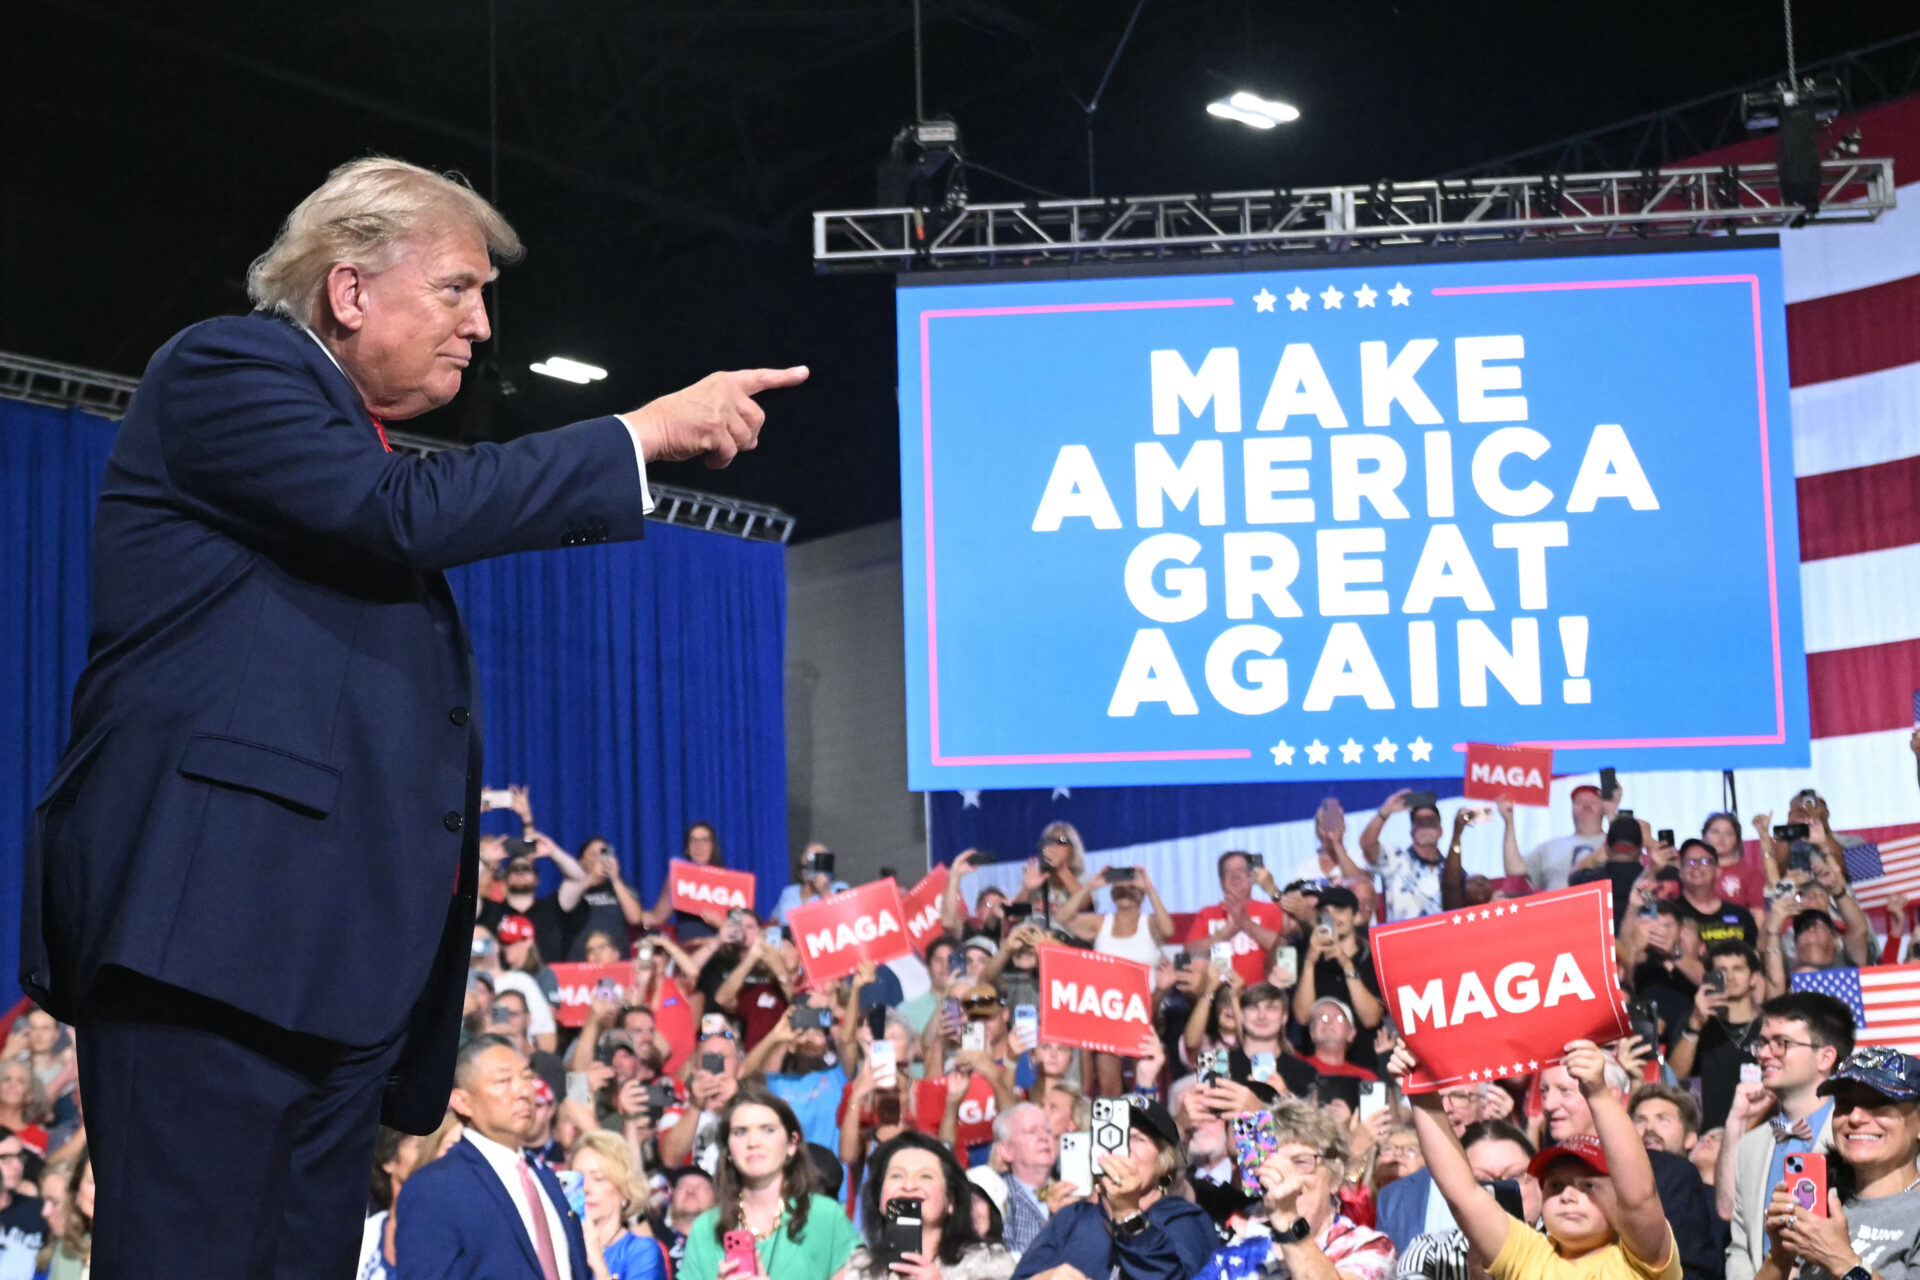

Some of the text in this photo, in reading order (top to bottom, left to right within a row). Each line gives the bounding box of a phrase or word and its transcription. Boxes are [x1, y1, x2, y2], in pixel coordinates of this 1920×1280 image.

[1150, 334, 1529, 436] MAKE
[1031, 423, 1661, 533] AMERICA
[1123, 520, 1570, 624] GREAT
[1106, 615, 1592, 718] AGAIN!
[1471, 763, 1544, 789] MAGA
[677, 879, 748, 909] MAGA
[805, 909, 900, 959] MAGA
[1050, 978, 1150, 1026] MAGA
[1397, 951, 1597, 1036] MAGA
